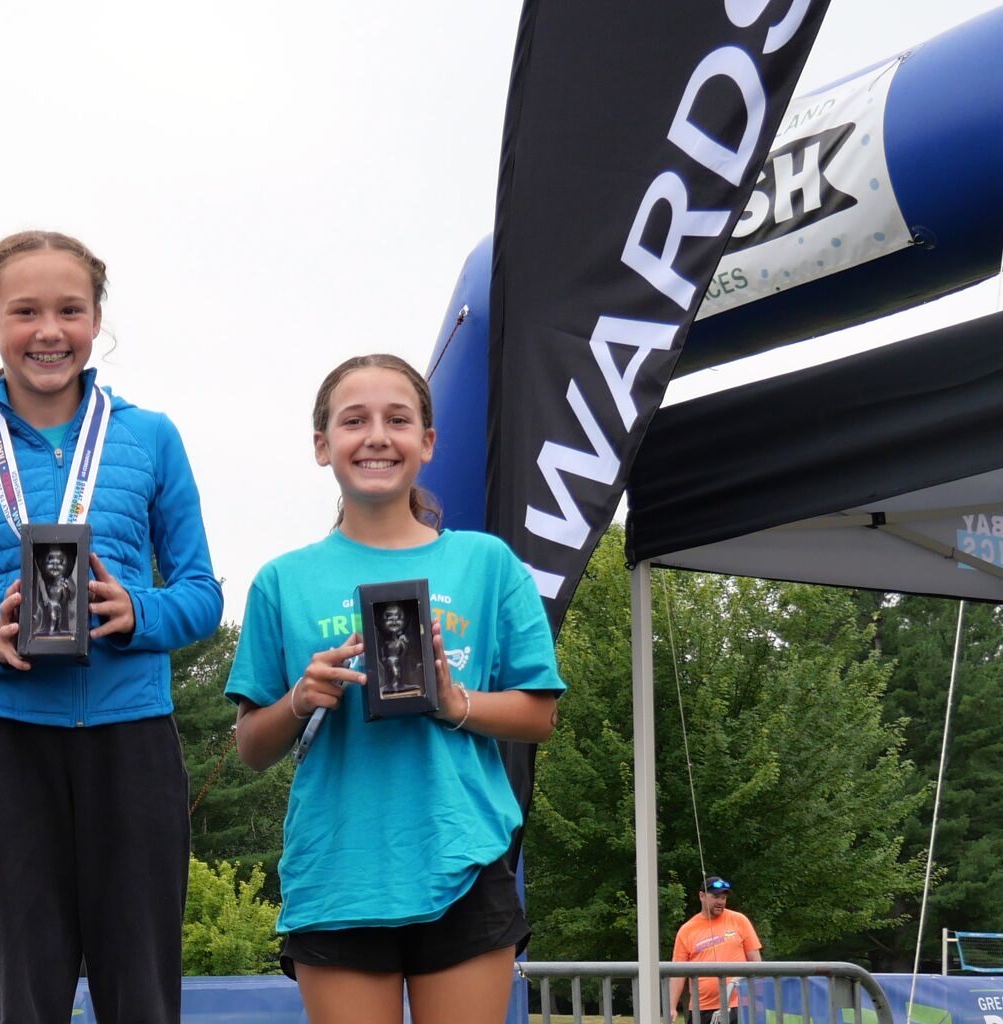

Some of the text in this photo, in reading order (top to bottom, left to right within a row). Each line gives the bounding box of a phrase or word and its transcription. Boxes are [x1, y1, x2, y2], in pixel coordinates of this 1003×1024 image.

[731, 141, 821, 238] SH
[68, 481, 81, 523] ORTHODONT
[430, 593, 452, 604] AND
[977, 996, 1003, 1011] GRE
